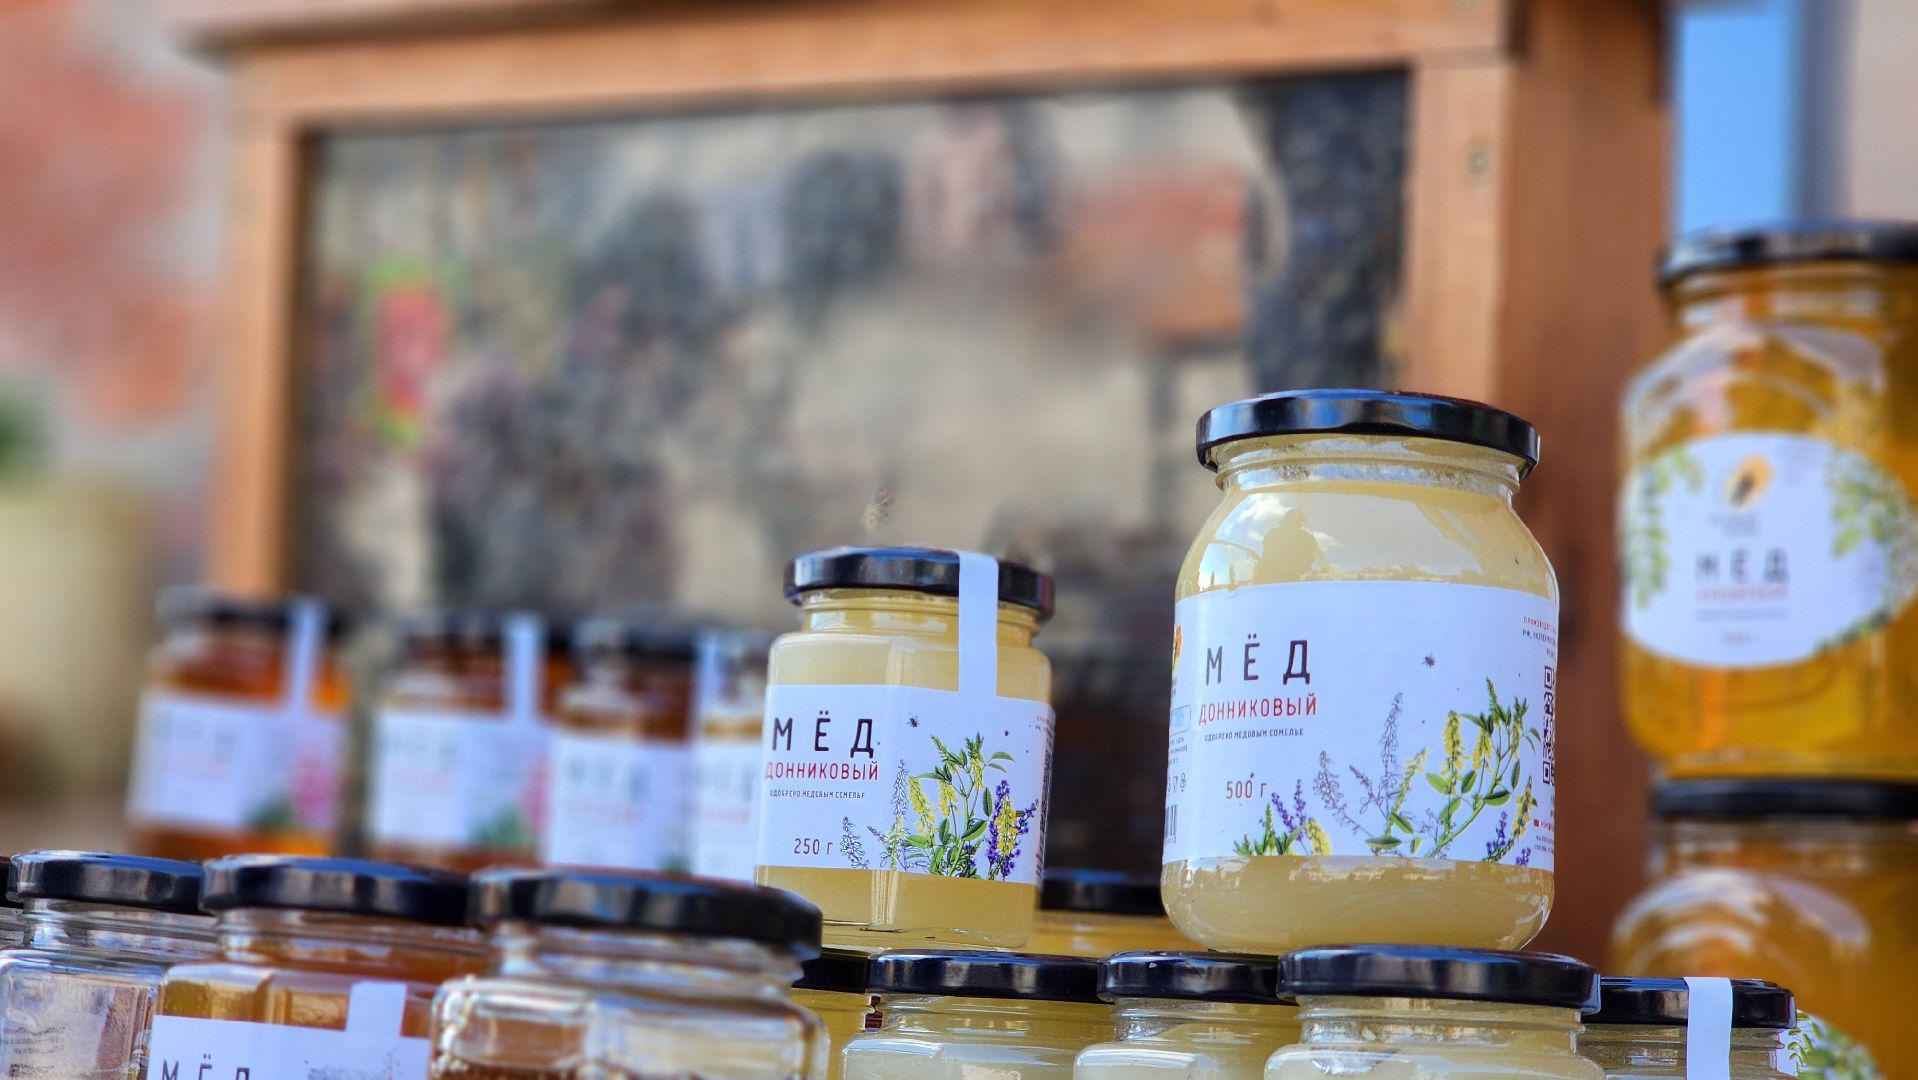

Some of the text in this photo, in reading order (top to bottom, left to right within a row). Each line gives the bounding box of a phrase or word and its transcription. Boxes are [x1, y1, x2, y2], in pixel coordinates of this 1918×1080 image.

[1205, 633, 1311, 686] МЁД
[1198, 692, 1317, 725] ДОННИКОВЫЙ
[771, 710, 874, 759] МЁД
[1234, 730, 1267, 740] МЕДОВЫМ
[1269, 728, 1304, 738] СОМЕЛЬЕ
[764, 760, 879, 781] ДОННИКОВЫЙ
[801, 790, 833, 799] МЕДОВЫМ
[834, 791, 865, 799] СОМЕЛЬЕ
[1226, 780, 1268, 800] 500 г
[793, 838, 834, 856] 250 г
